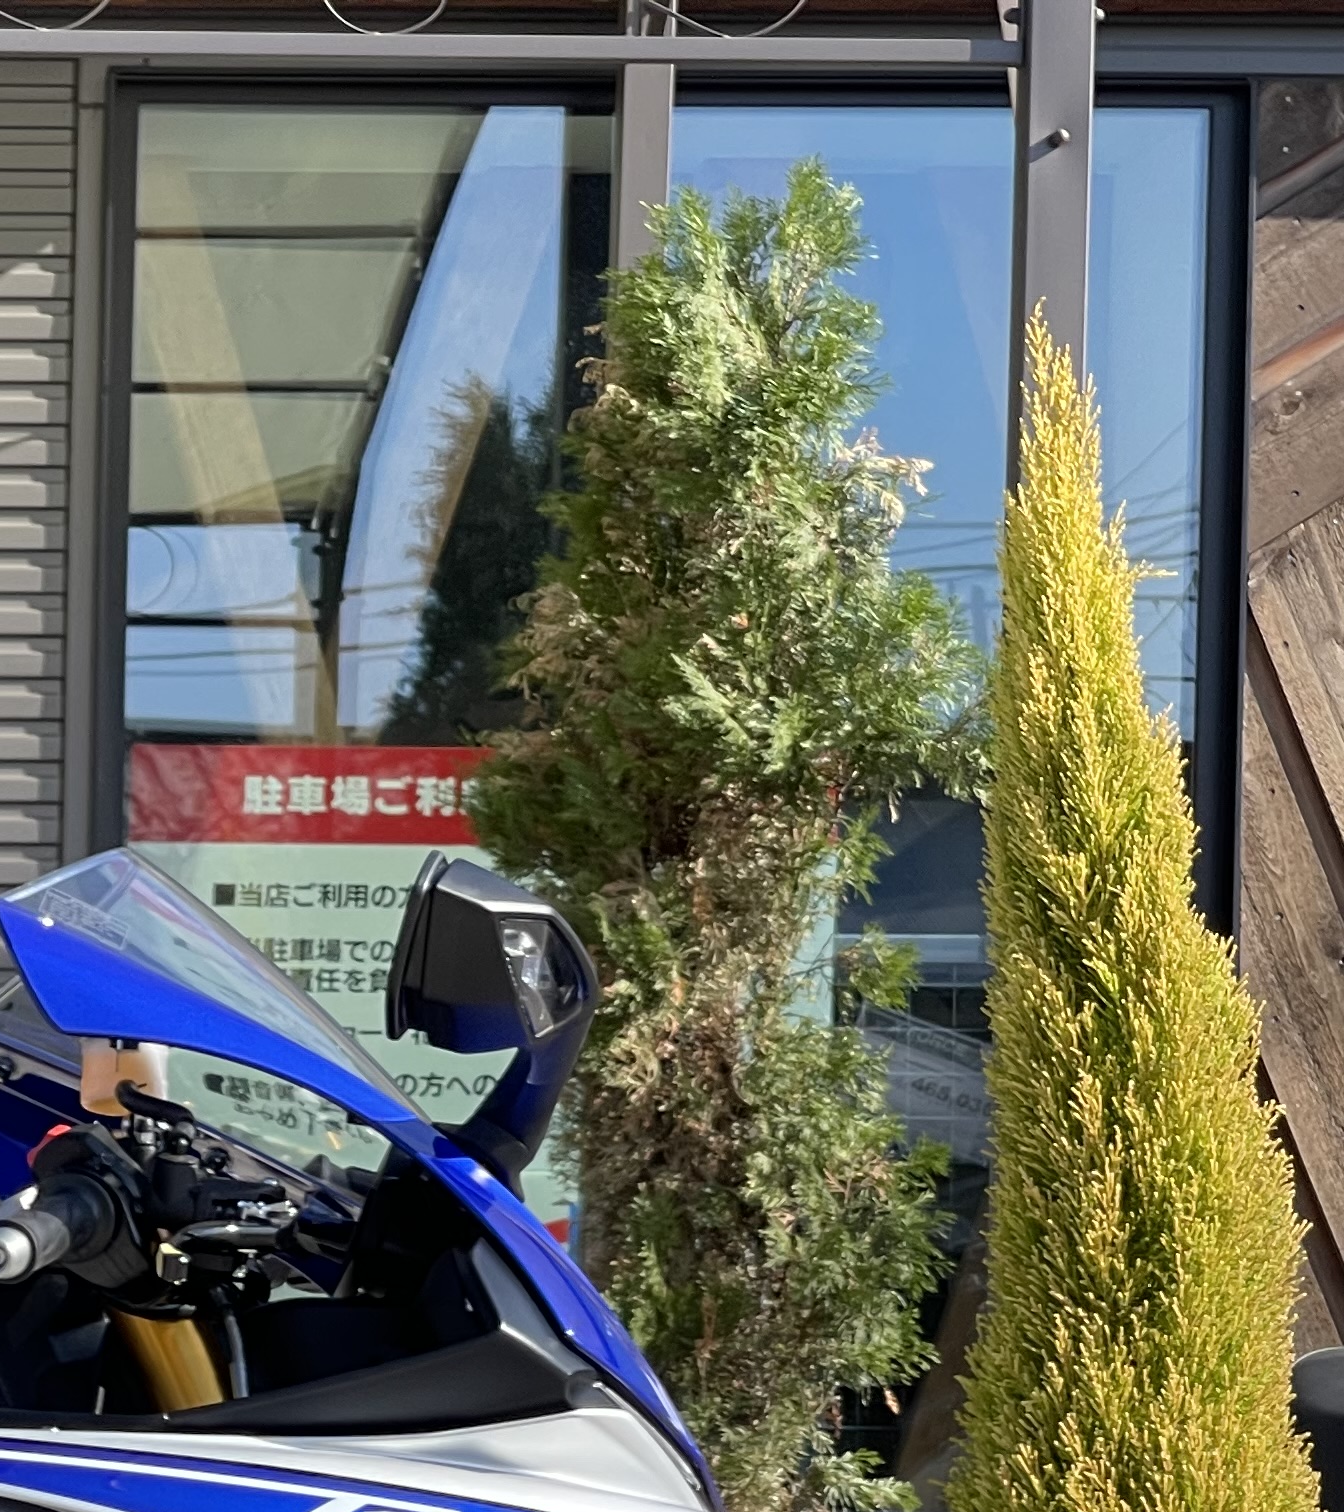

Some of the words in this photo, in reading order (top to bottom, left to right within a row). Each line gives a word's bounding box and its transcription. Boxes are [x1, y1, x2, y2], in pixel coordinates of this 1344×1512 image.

[251, 937, 395, 962] 駐車場での
